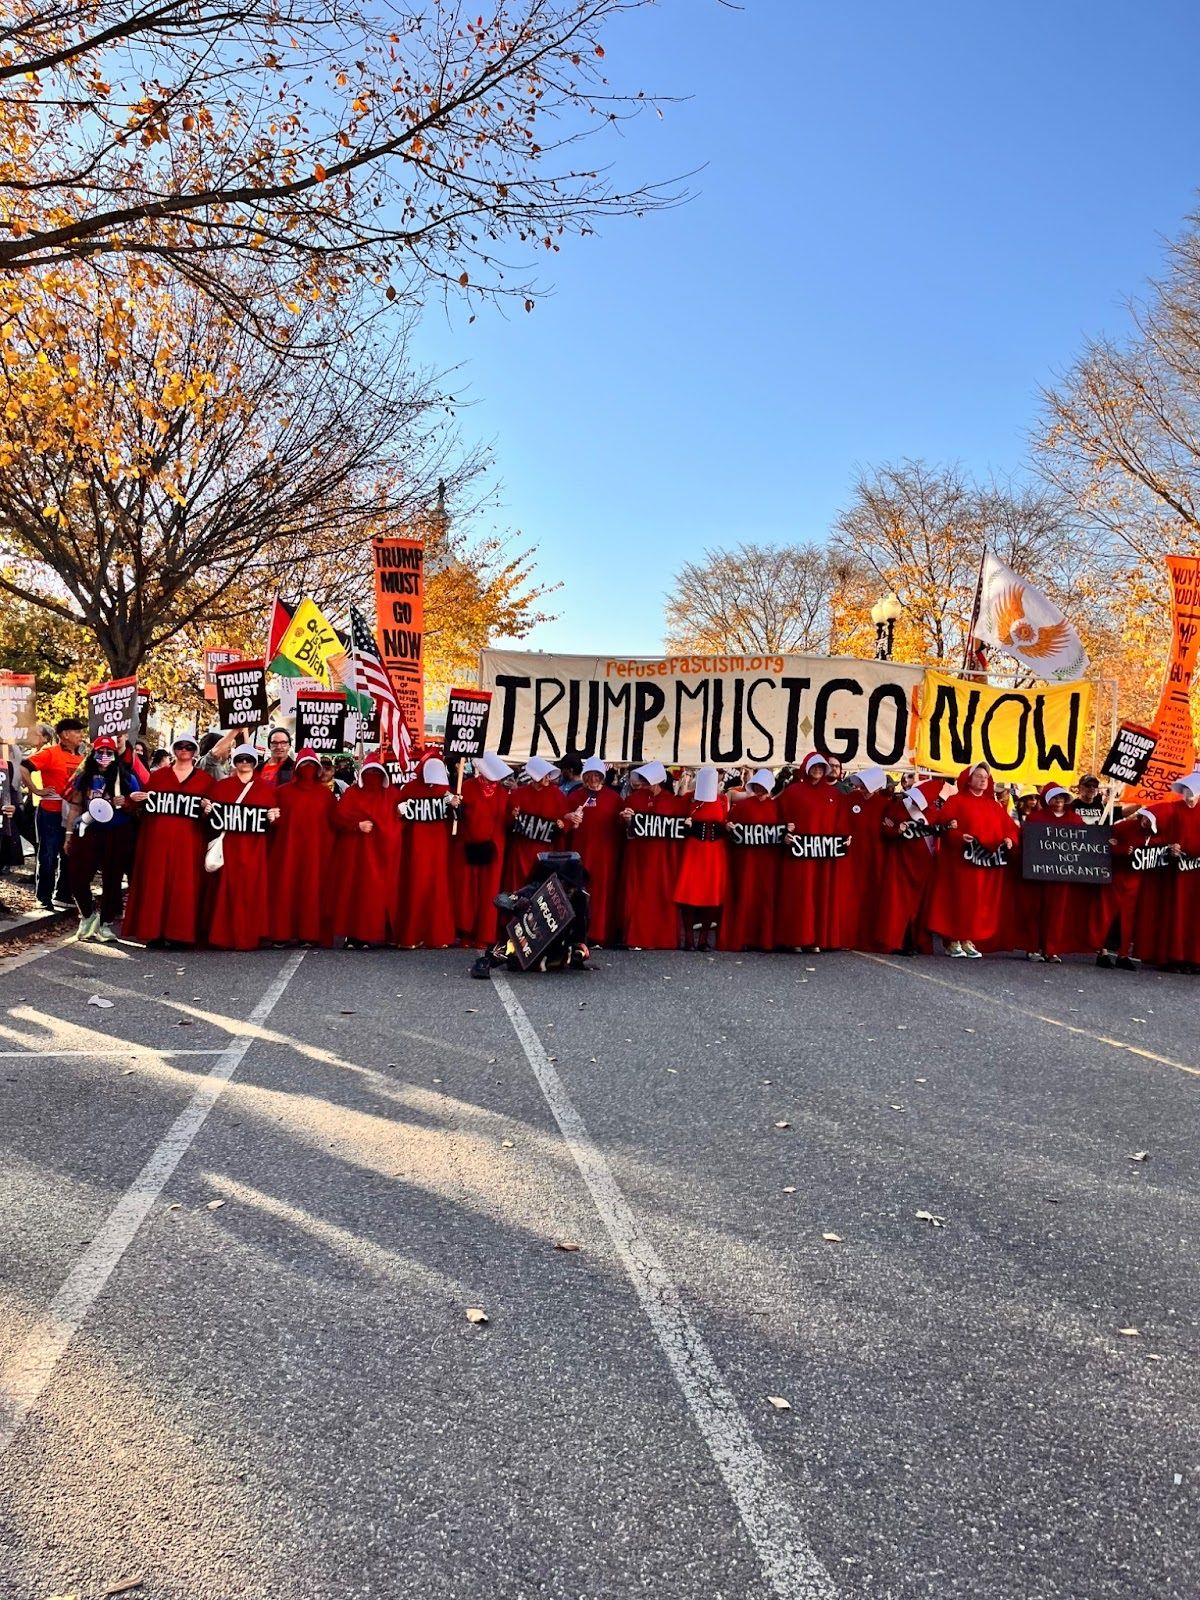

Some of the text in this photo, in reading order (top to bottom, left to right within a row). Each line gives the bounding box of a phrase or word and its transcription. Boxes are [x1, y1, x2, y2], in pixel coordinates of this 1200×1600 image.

[373, 546, 422, 570] TRUMP
[380, 571, 420, 596] MUST
[393, 601, 412, 625] GO
[383, 629, 421, 660] NOW
[218, 671, 263, 687] TRUMP
[0, 687, 32, 699] UMP
[90, 686, 135, 705] TRUMP
[223, 684, 259, 700] MUST
[94, 698, 131, 715] MUST
[233, 698, 253, 711] GO
[298, 701, 343, 714] TRUMP
[451, 699, 489, 715] TRUMP
[103, 711, 123, 721] GO
[228, 710, 262, 725] NOW!
[302, 713, 338, 725] MUST
[452, 713, 483, 728] MUST
[496, 675, 908, 766] TRUMP MUST GO
[0, 728, 28, 740] OW!
[98, 719, 132, 736] NOW!
[310, 726, 329, 737] GO
[457, 727, 475, 740] GO
[930, 685, 1080, 771] NOW
[303, 738, 337, 750] NOW!
[449, 740, 479, 754] NOW!
[1120, 730, 1155, 750] TRUMP
[1118, 742, 1147, 761] MUST
[1120, 755, 1136, 768] GO
[391, 772, 418, 784] MUS
[1109, 763, 1138, 780] NOW!
[1146, 766, 1184, 782] EFUSE
[145, 790, 202, 818] SHAME
[210, 802, 268, 833] SHAME
[1075, 808, 1102, 817] RESIST
[512, 813, 557, 843] HAME
[634, 813, 686, 839] SHAME
[733, 823, 786, 845] SHAME
[1045, 826, 1088, 840] FIGHT
[791, 834, 846, 859] SHAME
[1039, 839, 1110, 854] IGNORANCE
[1058, 853, 1081, 863] NOT
[1032, 864, 1111, 879] IMMIGRANTS
[537, 895, 559, 932] IMPEACH
